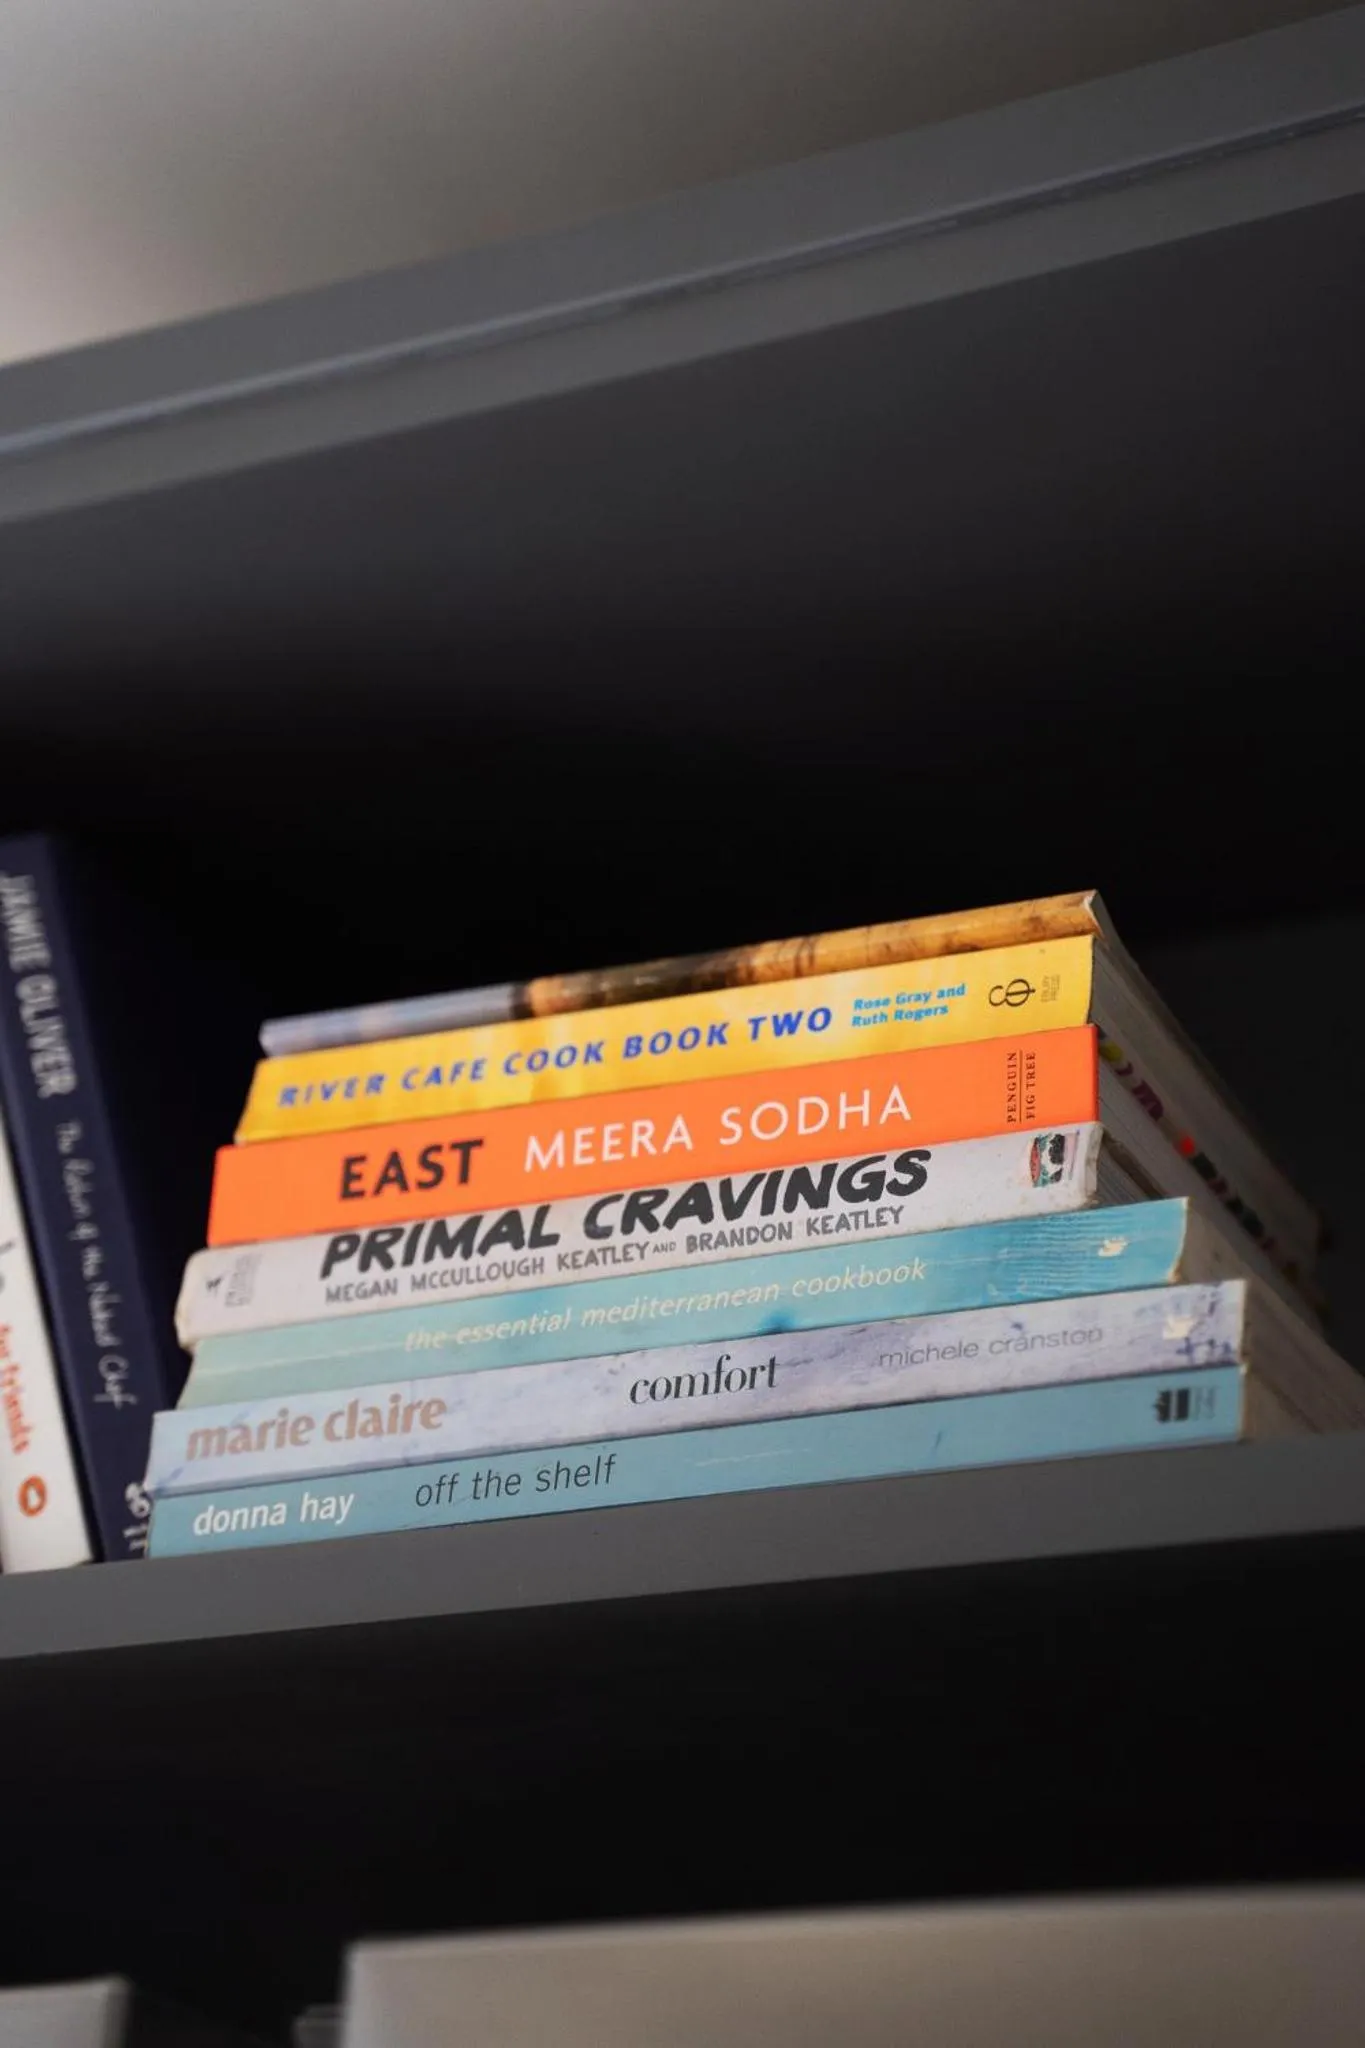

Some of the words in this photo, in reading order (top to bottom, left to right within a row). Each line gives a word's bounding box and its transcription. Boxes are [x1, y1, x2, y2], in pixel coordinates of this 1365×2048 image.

[851, 1013, 888, 1027] Ruth
[894, 1004, 949, 1021] Rogers
[854, 996, 891, 1010] Rose
[896, 990, 931, 1006] Gray
[936, 983, 965, 999] and
[16, 974, 76, 1098] OLIVER
[278, 1074, 385, 1107] RIVER
[401, 1057, 488, 1091] CAFE
[503, 1041, 605, 1078] COOK
[622, 1022, 729, 1058] BOOK
[748, 1006, 832, 1041] TWO
[1007, 1052, 1017, 1123] PENGUIN
[1026, 1052, 1036, 1088] TREE
[524, 1114, 693, 1173] MEERA
[719, 1085, 911, 1146] SODHA
[1026, 1095, 1036, 1120] FIG
[338, 1138, 484, 1201] EAST
[320, 1204, 560, 1280] PRIMAL
[583, 1149, 931, 1239] CRAVINGS
[325, 1277, 398, 1305] MEGAN
[411, 1256, 545, 1293] MCCULLOUGH
[557, 1241, 652, 1271] KEATLEY
[653, 1241, 676, 1257] AND
[686, 1220, 793, 1255] BRANDON
[806, 1205, 905, 1238] KEATLEY
[405, 1327, 443, 1353] the
[455, 1308, 572, 1344] essential
[581, 1281, 779, 1327] mediterranean
[792, 1258, 926, 1295] cookbook
[629, 1354, 779, 1405] comfort
[878, 1338, 979, 1369] michele
[185, 1408, 315, 1462] marie
[324, 1394, 447, 1442] claire
[415, 1474, 460, 1507] off
[472, 1469, 522, 1500] the
[535, 1453, 617, 1493] shelf
[193, 1503, 286, 1537] donna
[300, 1492, 354, 1525] hay
